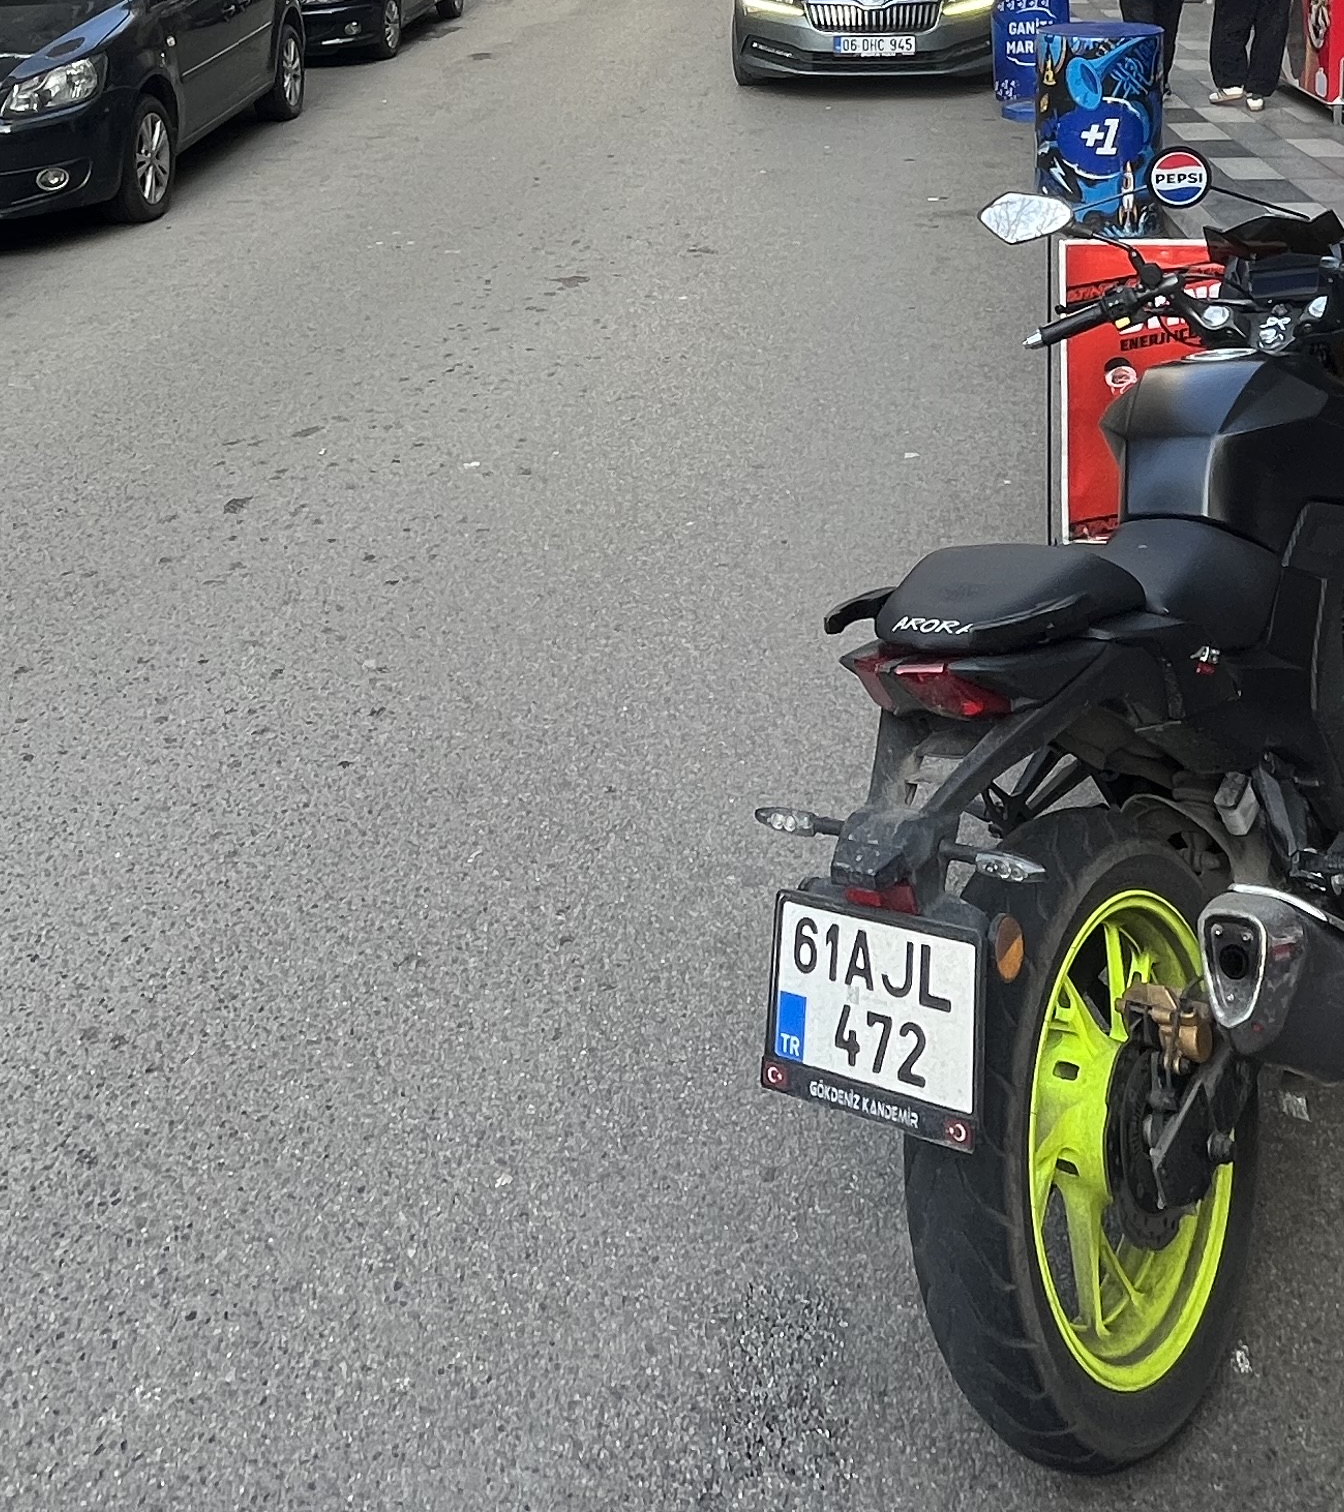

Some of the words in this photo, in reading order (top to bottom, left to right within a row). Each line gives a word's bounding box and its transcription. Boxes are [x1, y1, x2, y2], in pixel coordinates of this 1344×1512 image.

[843, 39, 858, 52] 06
[889, 38, 913, 51] 945
[1080, 118, 1120, 155] +1
[1155, 173, 1204, 185] PEPSI
[780, 1032, 801, 1057] TR
[834, 1004, 927, 1089] 472
[809, 1079, 861, 1110] GÖKDENİZ
[862, 1096, 919, 1129] KANDEMİR
